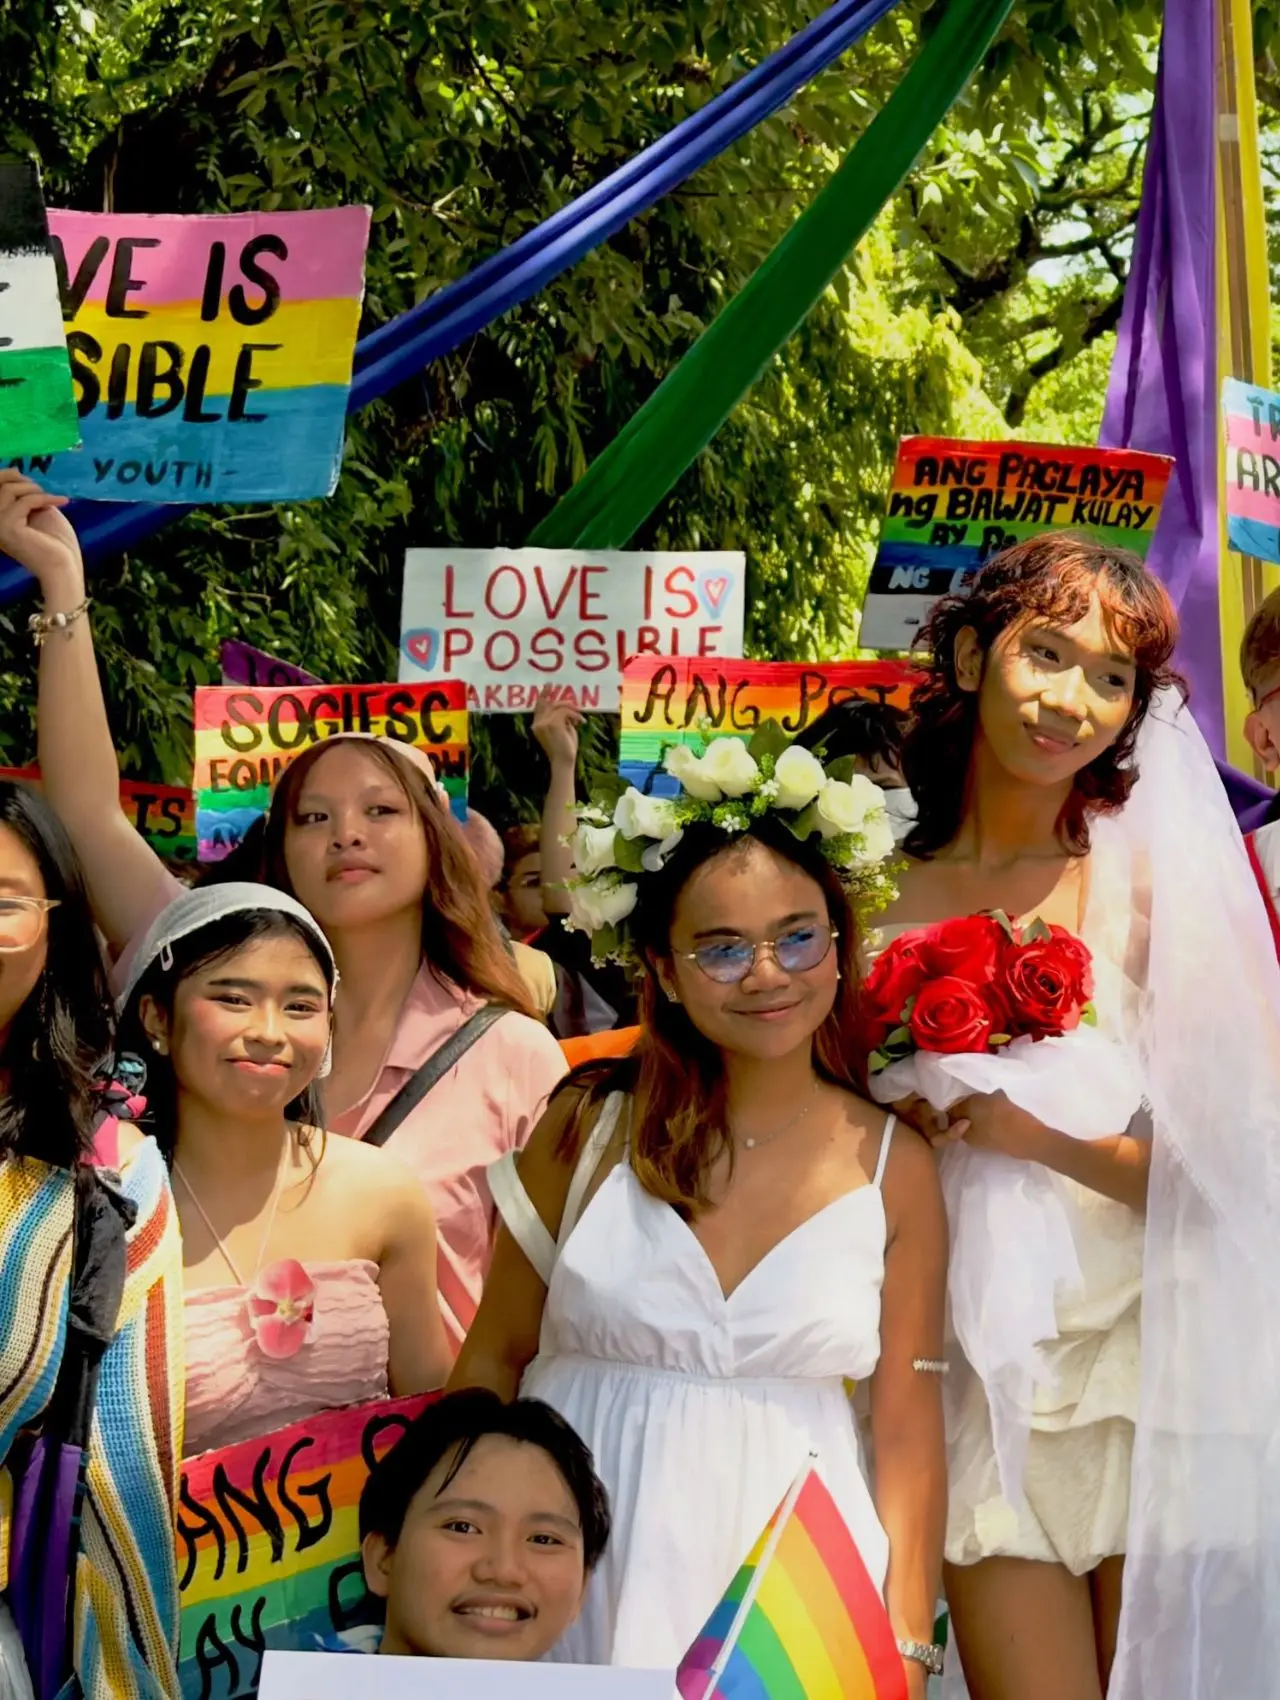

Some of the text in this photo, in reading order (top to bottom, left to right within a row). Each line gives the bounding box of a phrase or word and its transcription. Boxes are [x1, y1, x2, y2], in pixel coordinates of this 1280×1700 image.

[200, 234, 289, 326] IS
[914, 452, 1144, 501] ANG PAGLAYA
[888, 487, 1154, 529] ng BAWAT KULAY
[442, 565, 699, 621] LOVE IS
[888, 566, 931, 590] NG
[633, 664, 760, 730] ANG
[131, 793, 186, 838] IS
[177, 1436, 332, 1591] ANG
